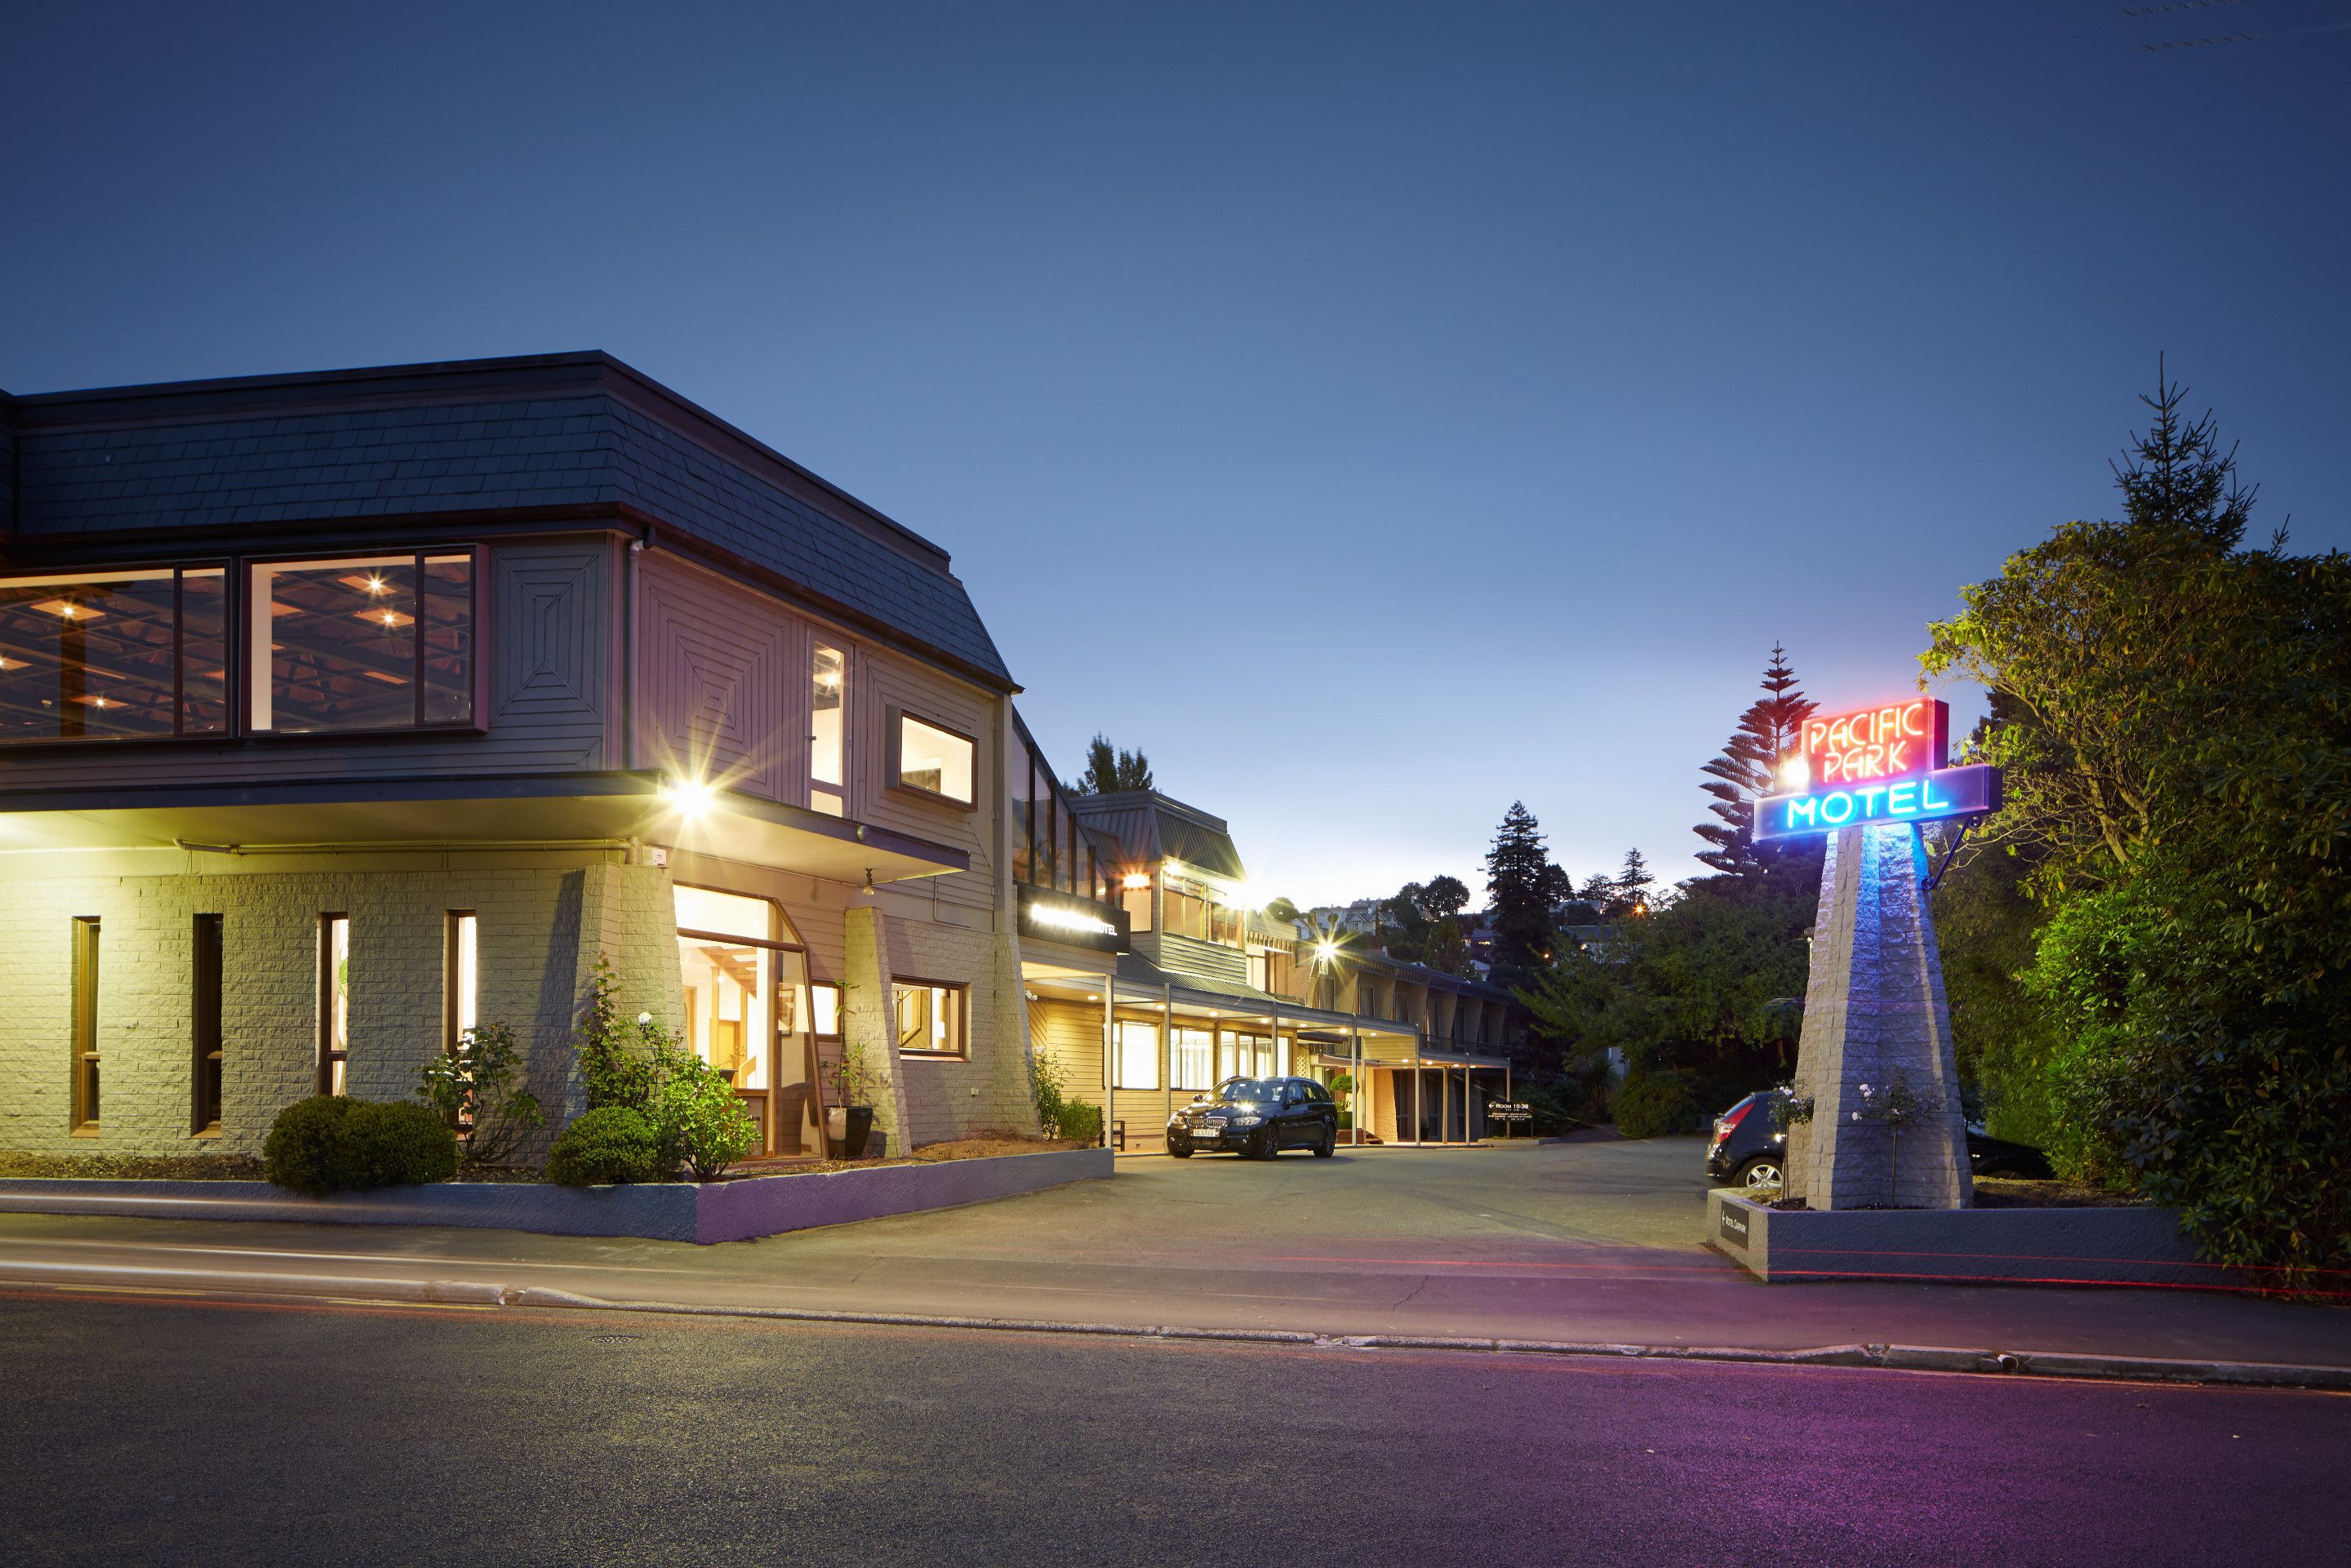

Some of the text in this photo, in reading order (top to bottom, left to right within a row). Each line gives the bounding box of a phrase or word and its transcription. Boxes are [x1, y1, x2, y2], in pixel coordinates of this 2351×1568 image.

[1811, 703, 1923, 753] PACIFIC
[1824, 740, 1907, 784] PARK
[1786, 780, 1949, 828] MOTEL
